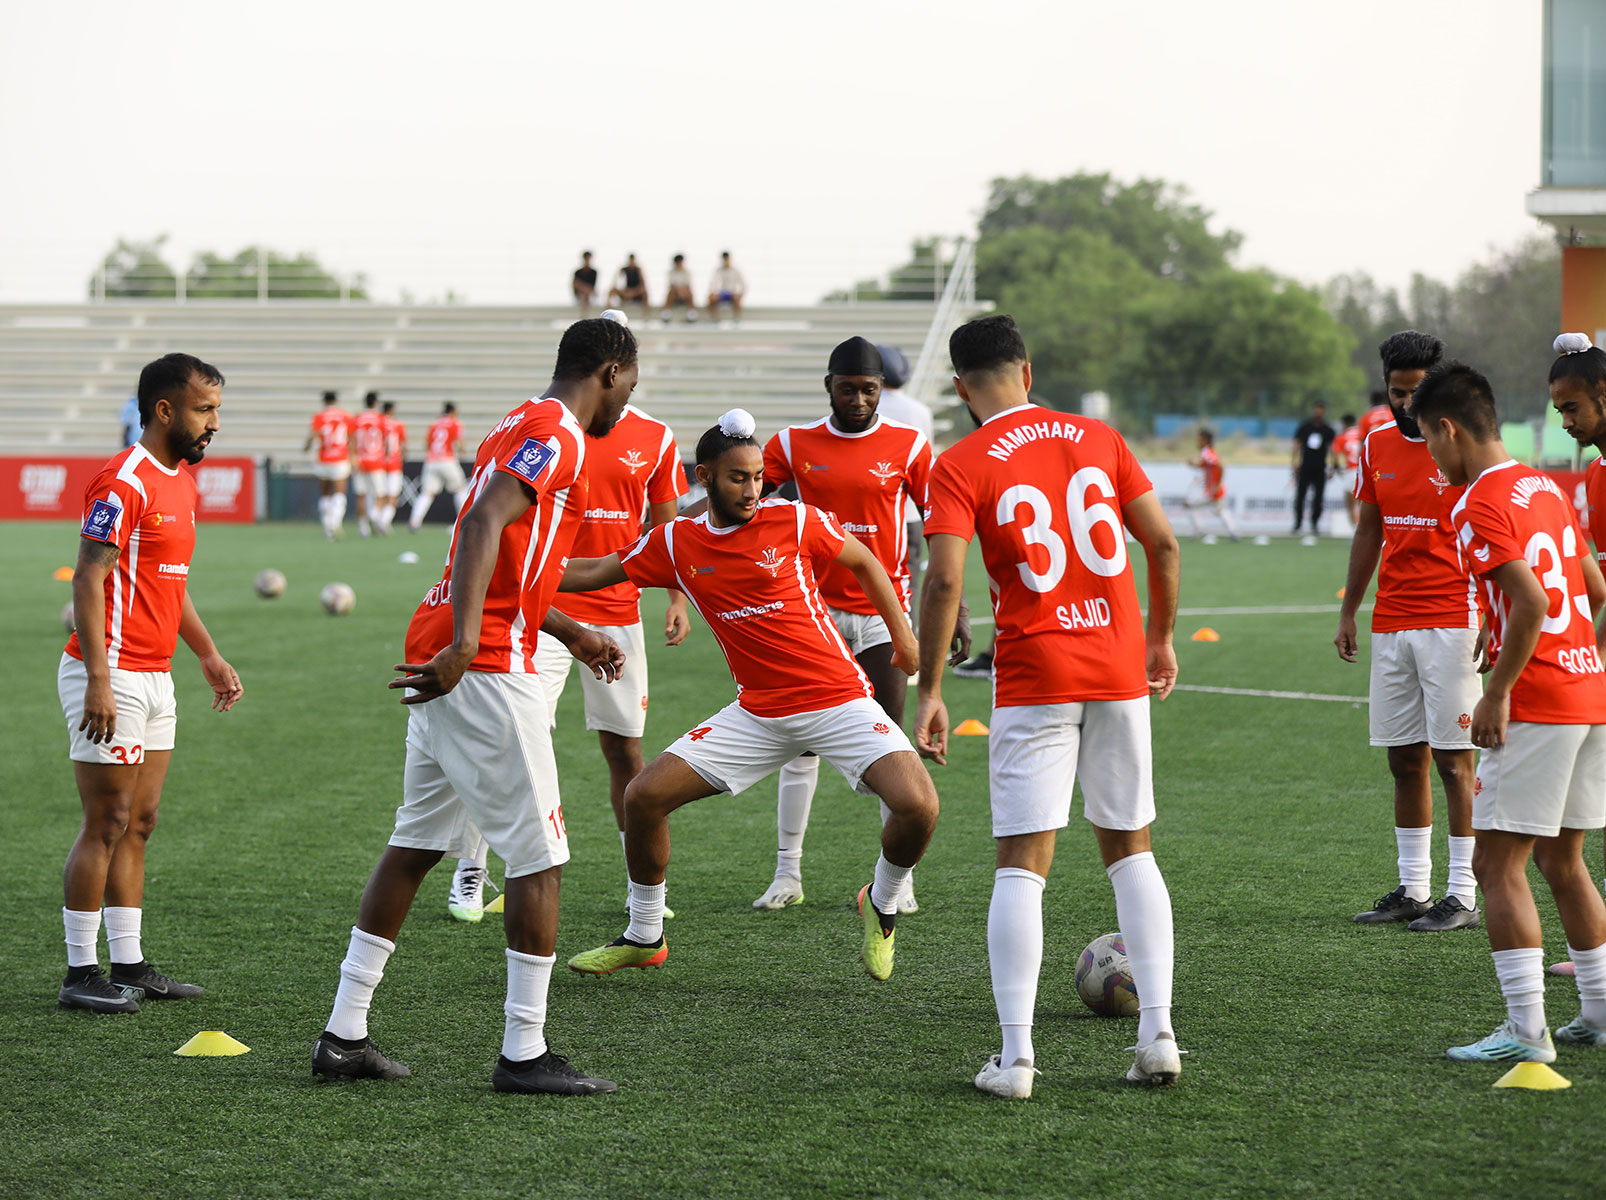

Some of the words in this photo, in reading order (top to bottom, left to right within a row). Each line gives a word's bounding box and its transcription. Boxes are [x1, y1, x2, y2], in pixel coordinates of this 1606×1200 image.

[987, 421, 1085, 462] NAMDHARI
[996, 466, 1128, 593] 36
[1055, 597, 1111, 630] SAJID
